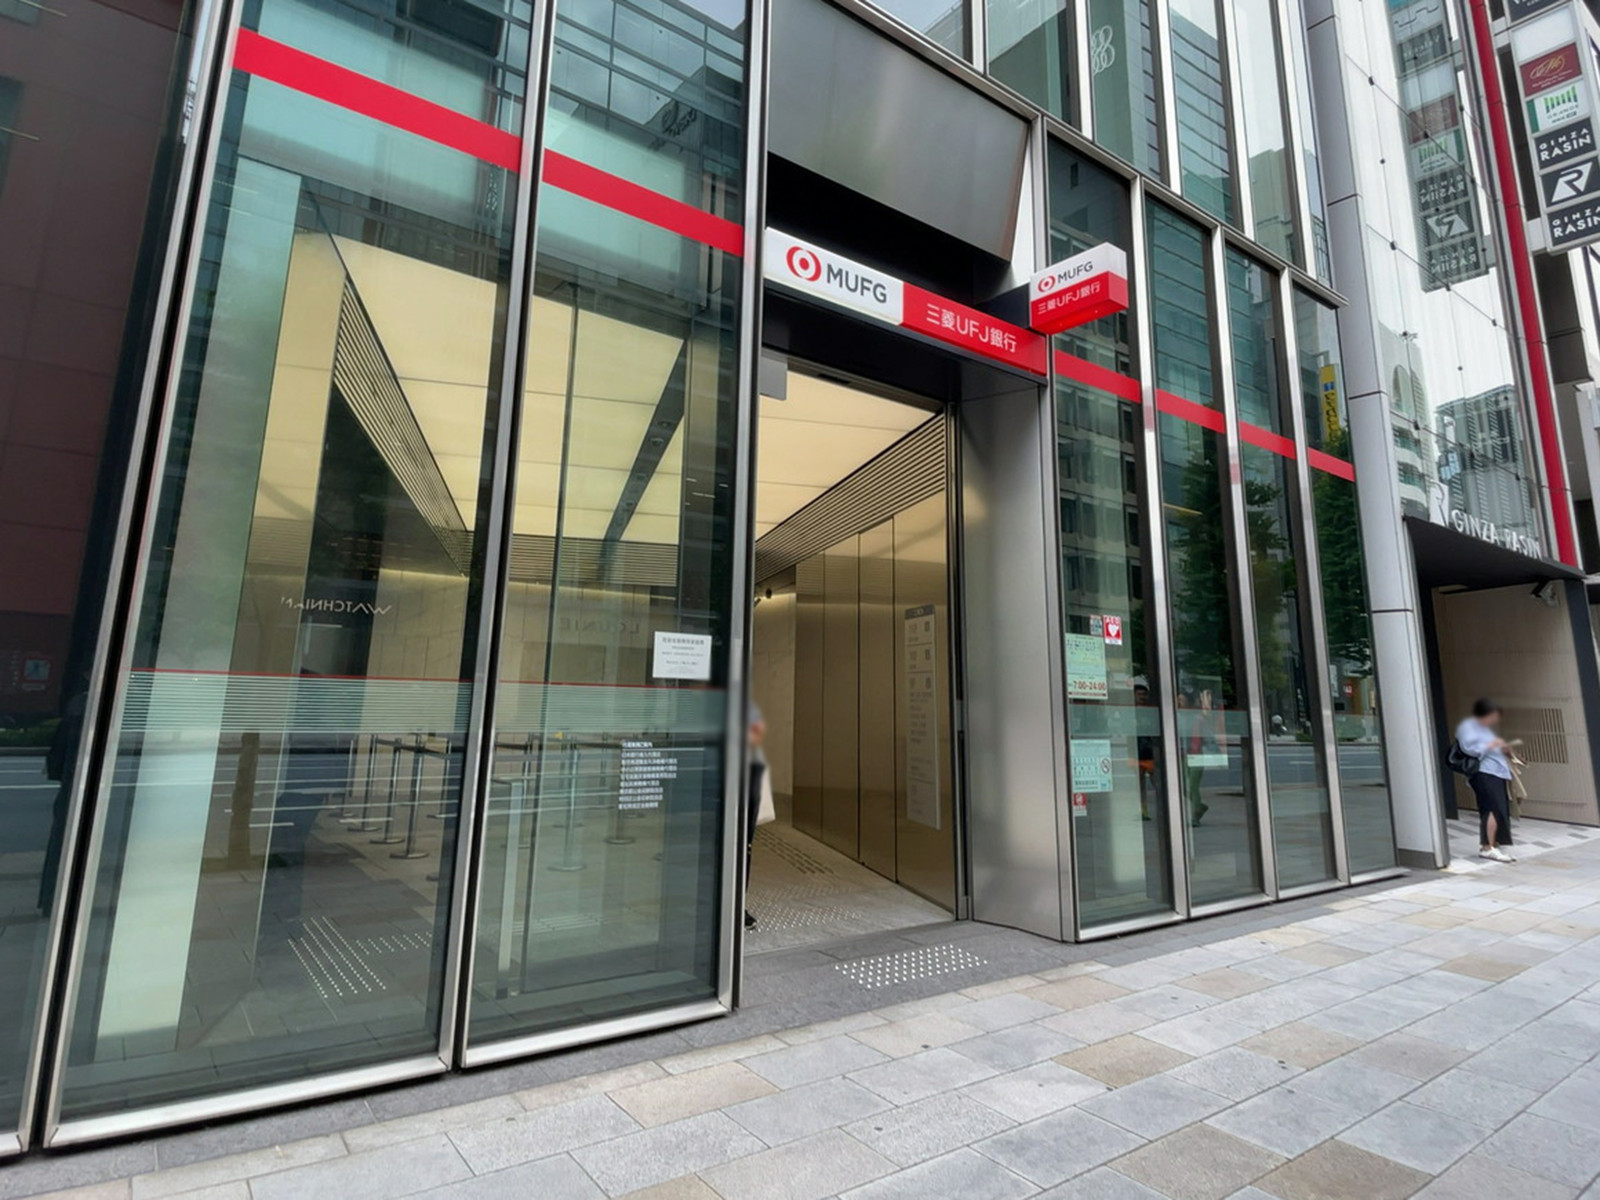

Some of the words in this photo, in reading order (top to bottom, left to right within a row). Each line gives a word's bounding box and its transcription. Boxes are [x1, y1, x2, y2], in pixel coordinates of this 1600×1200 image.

[1539, 128, 1589, 150] GINZA
[1540, 134, 1592, 161] RASIN
[826, 264, 887, 304] MUFG
[1057, 261, 1094, 283] MUFG
[1037, 281, 1101, 315] 三菱UFJ銀行
[926, 303, 1017, 353] 三菱UFJ銀行
[1451, 509, 1500, 545] GINZA
[1504, 528, 1543, 560] RASIN
